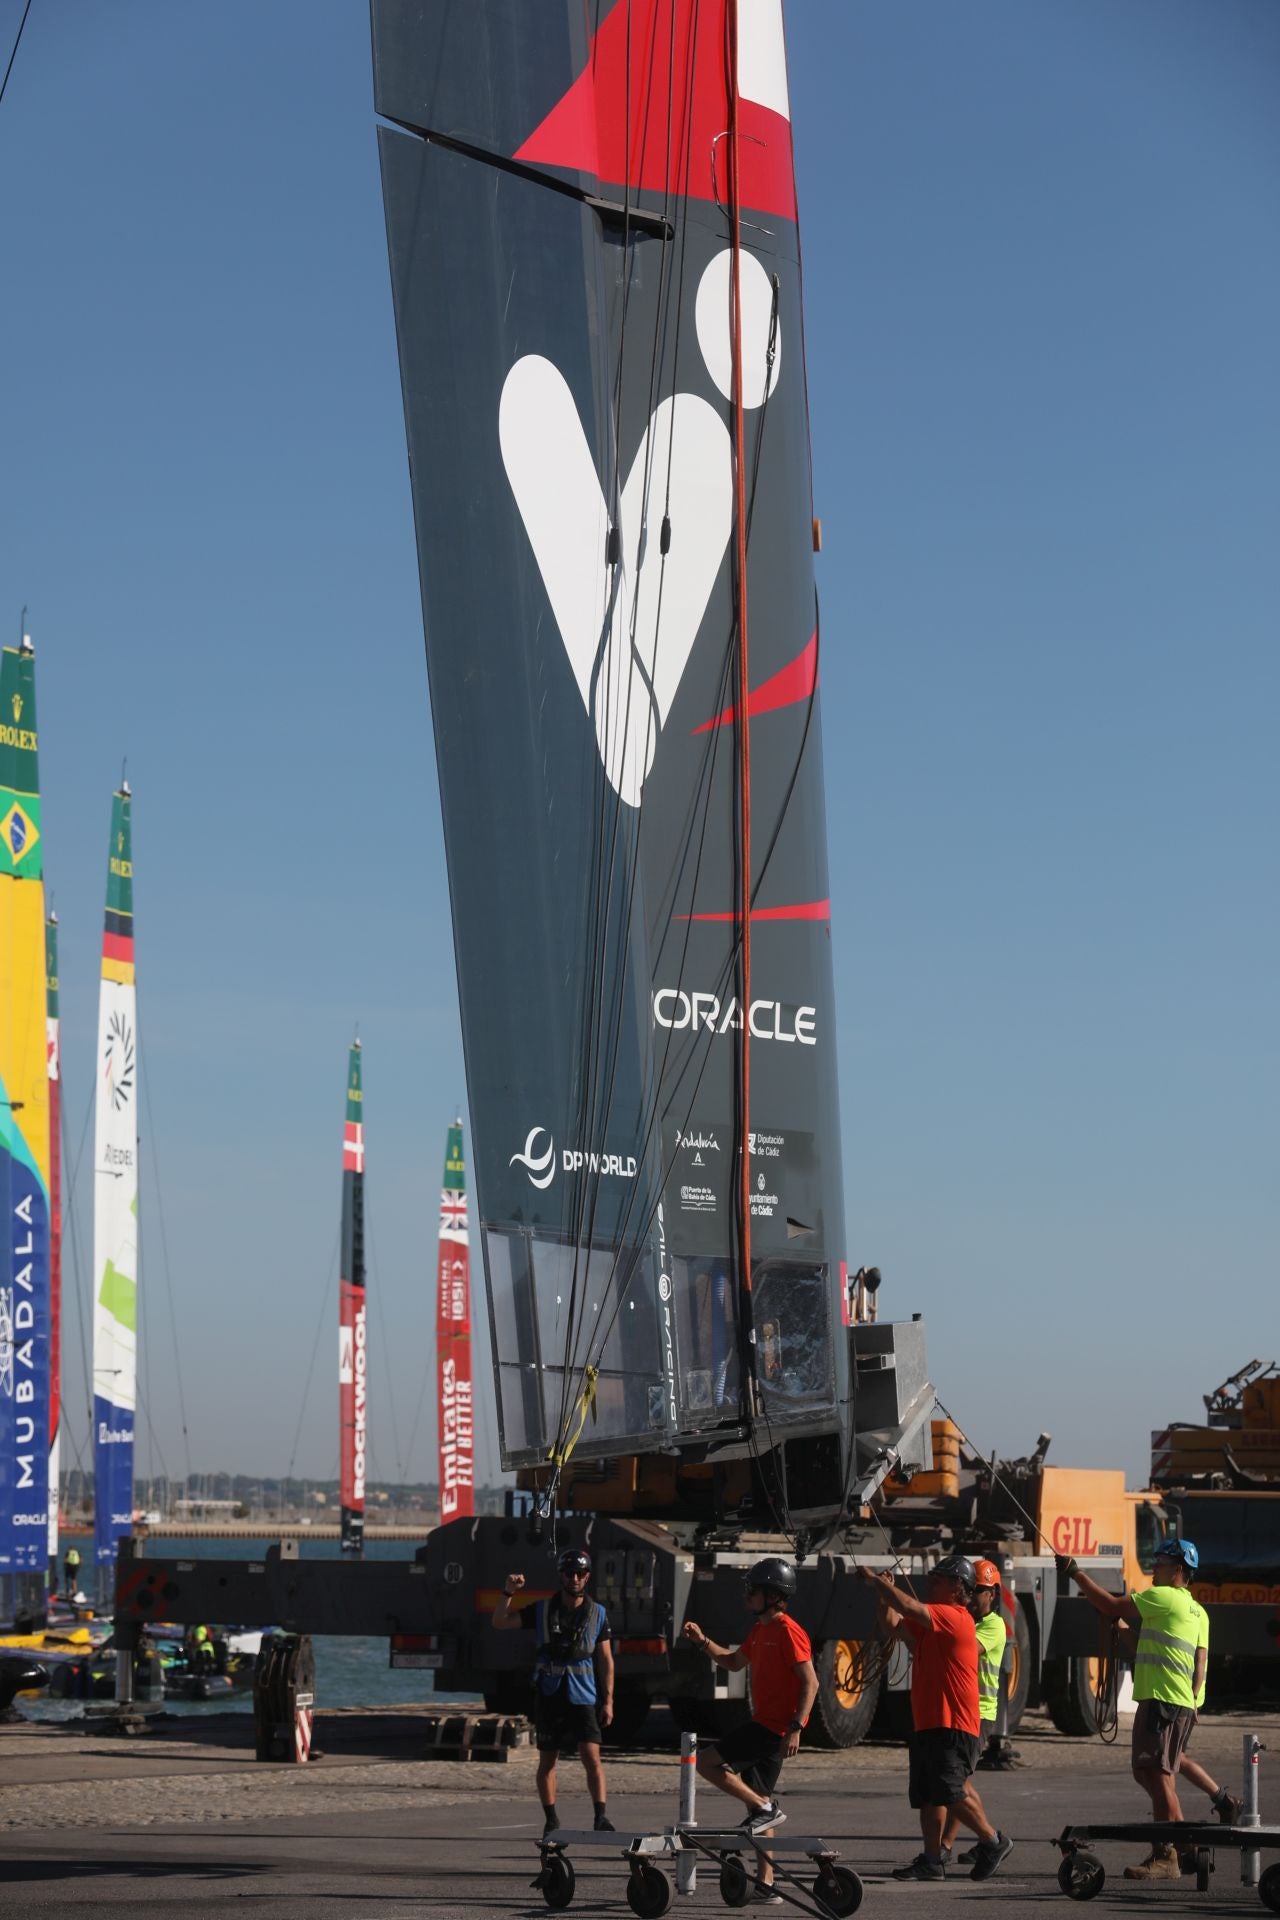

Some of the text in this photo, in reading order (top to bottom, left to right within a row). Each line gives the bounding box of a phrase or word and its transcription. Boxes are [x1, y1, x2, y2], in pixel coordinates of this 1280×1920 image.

[0, 724, 38, 751] ROLEX
[653, 988, 817, 1045] ORACLE
[757, 1133, 785, 1145] Diputación
[757, 1147, 764, 1155] de
[562, 1150, 638, 1177] DP WORLD
[748, 1194, 778, 1205] yuntamiento
[751, 1205, 758, 1215] de
[14, 1193, 35, 1489] MUBADALA
[664, 1307, 676, 1421] RACING
[354, 1304, 366, 1500] ROCKWOOL
[442, 1359, 458, 1515] Emirates
[456, 1381, 473, 1486] FLY BETTER
[12, 1514, 47, 1526] ORACLE
[1052, 1515, 1098, 1556] GIL
[447, 1564, 460, 1582] 80
[1197, 1588, 1228, 1603] GIL
